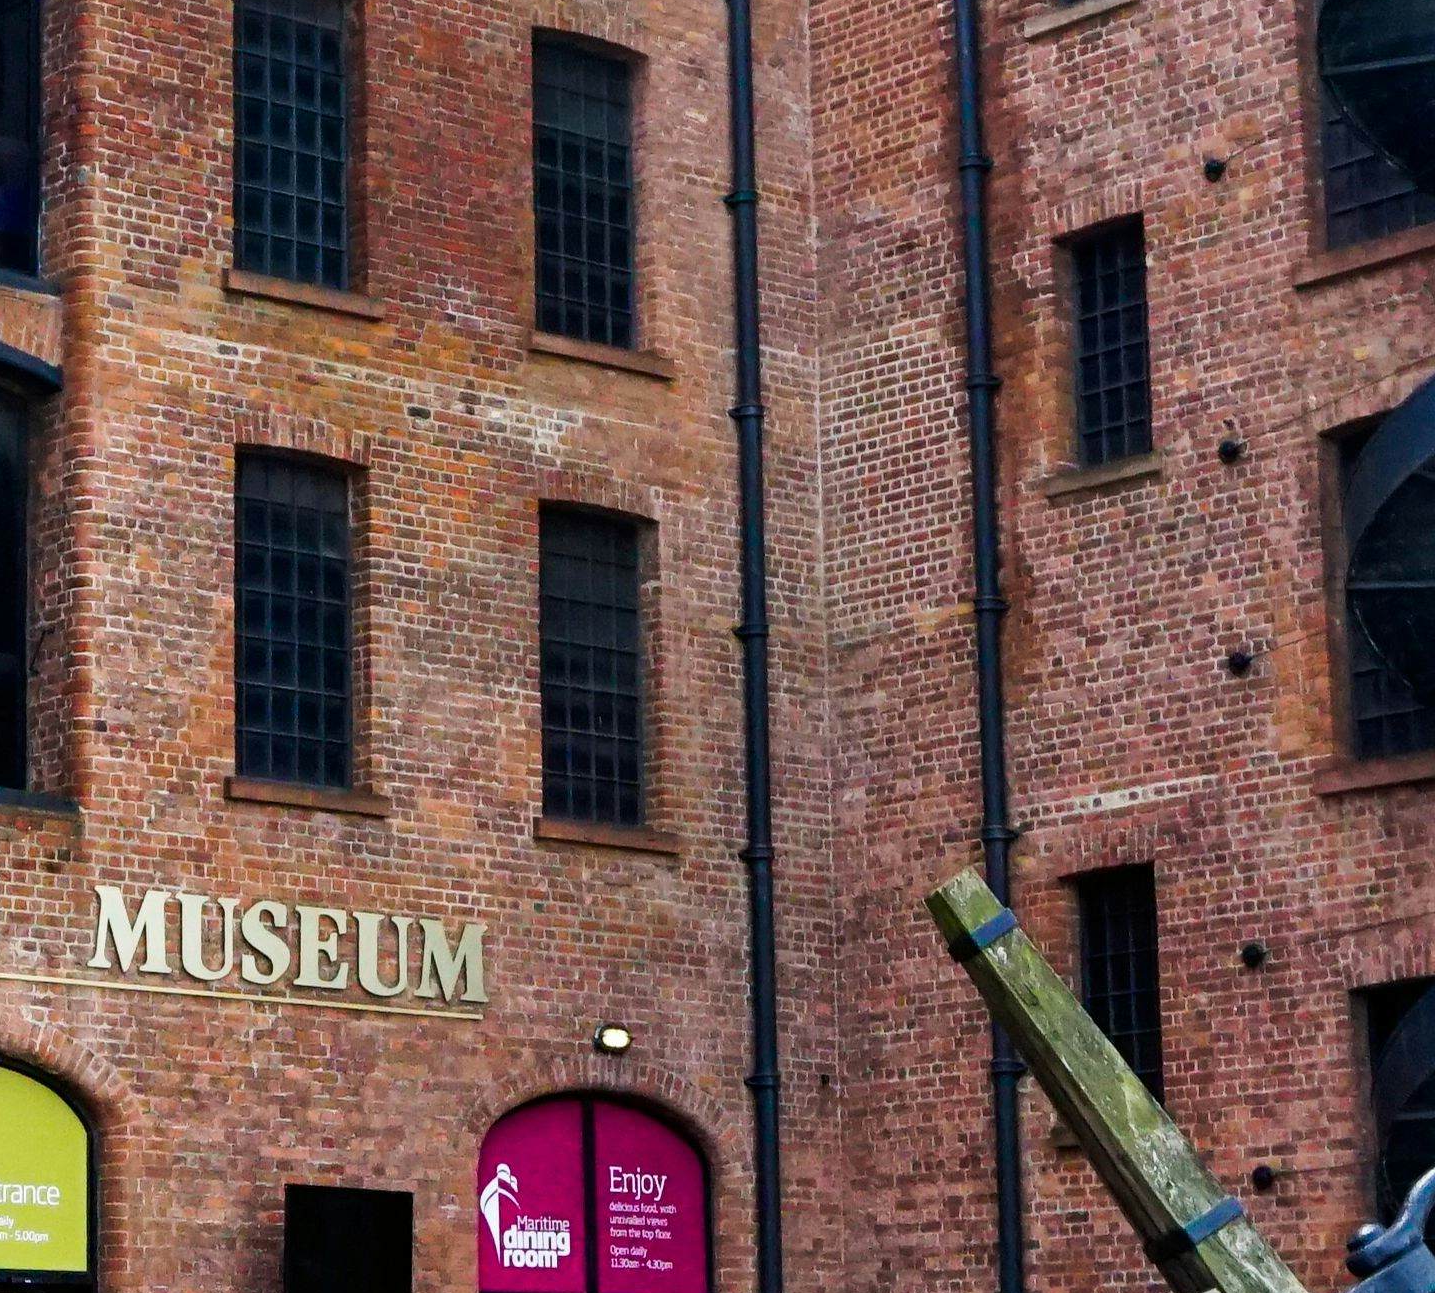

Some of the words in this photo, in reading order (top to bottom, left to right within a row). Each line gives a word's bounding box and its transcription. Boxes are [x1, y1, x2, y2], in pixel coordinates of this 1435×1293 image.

[87, 884, 488, 1004] MUSEUM
[609, 1166, 667, 1201] Enjoy
[517, 1215, 570, 1232] Maritime
[14, 1229, 49, 1243] 5.00pm
[503, 1225, 571, 1256] dining
[609, 1228, 628, 1238] from
[629, 1228, 641, 1239] the
[642, 1230, 654, 1241] top
[504, 1249, 558, 1268] room
[610, 1245, 629, 1256] Open
[631, 1246, 648, 1257] daily
[611, 1258, 640, 1268] 11.30am
[646, 1260, 673, 1271] 4.30pm
